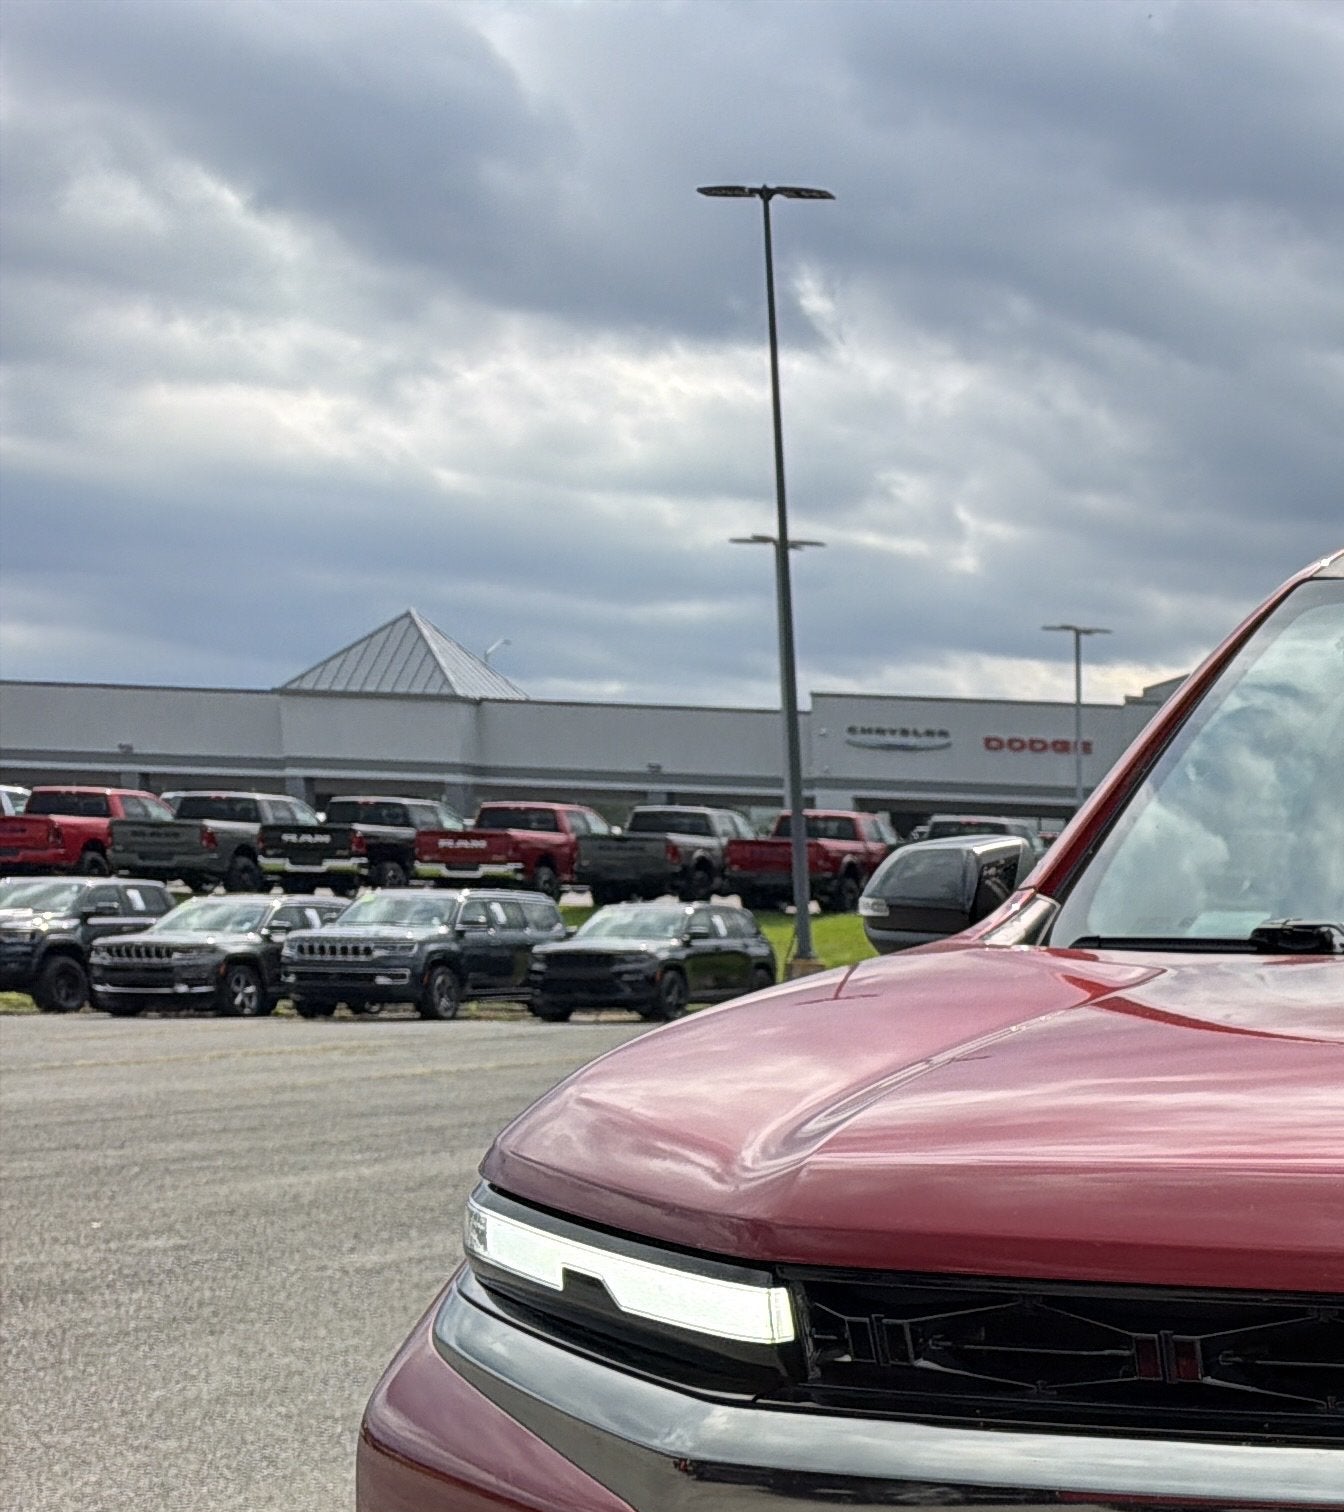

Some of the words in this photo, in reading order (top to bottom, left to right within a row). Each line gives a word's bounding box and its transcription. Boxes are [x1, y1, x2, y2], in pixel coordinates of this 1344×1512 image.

[847, 725, 950, 738] CHRYSLER
[983, 735, 1093, 755] DODGE
[280, 832, 331, 844] RAM
[437, 837, 488, 849] RAM
